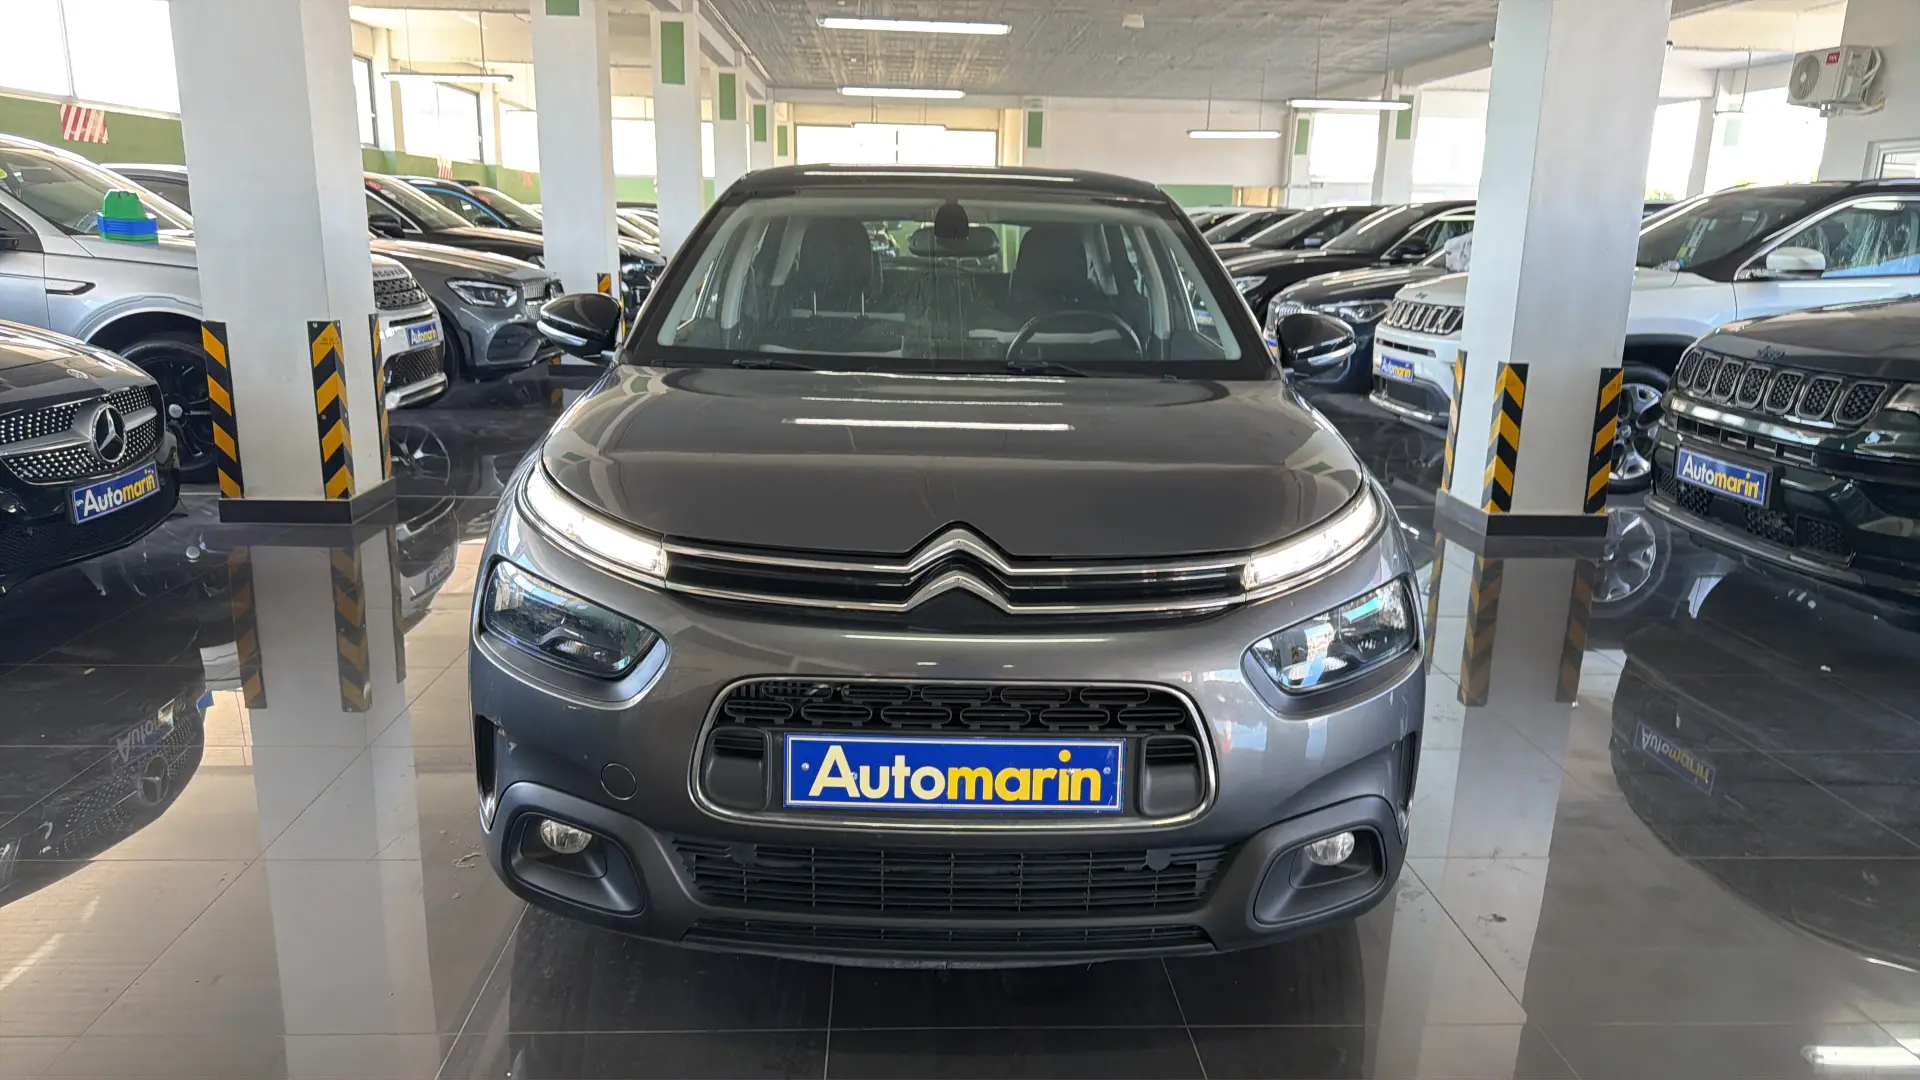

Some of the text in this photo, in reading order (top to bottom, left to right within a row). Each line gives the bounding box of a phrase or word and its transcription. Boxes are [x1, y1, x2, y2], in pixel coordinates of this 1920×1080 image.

[84, 469, 155, 516] Automarin
[1682, 455, 1759, 499] Automarin
[809, 745, 1101, 801] Automarin
